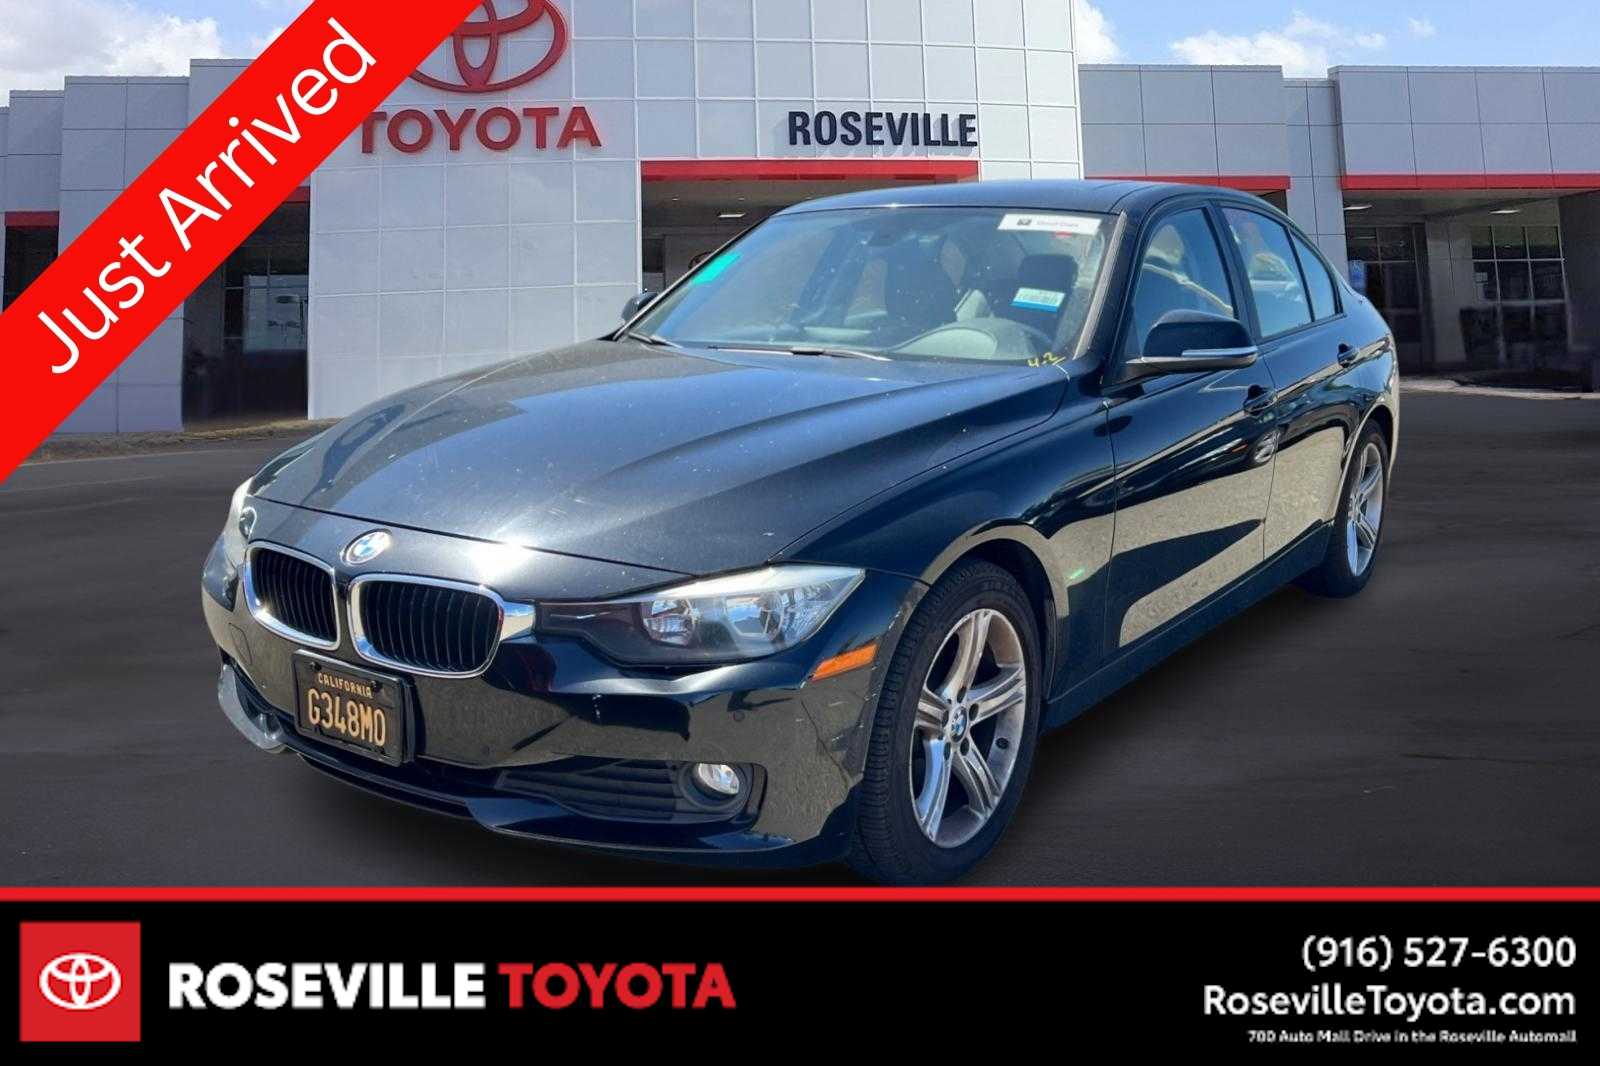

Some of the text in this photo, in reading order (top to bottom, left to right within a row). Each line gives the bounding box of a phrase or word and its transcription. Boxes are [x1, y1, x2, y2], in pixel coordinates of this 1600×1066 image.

[360, 105, 602, 153] TOYOTA
[788, 110, 978, 146] ROSEVILLE
[318, 672, 374, 699] CALIFORNIA
